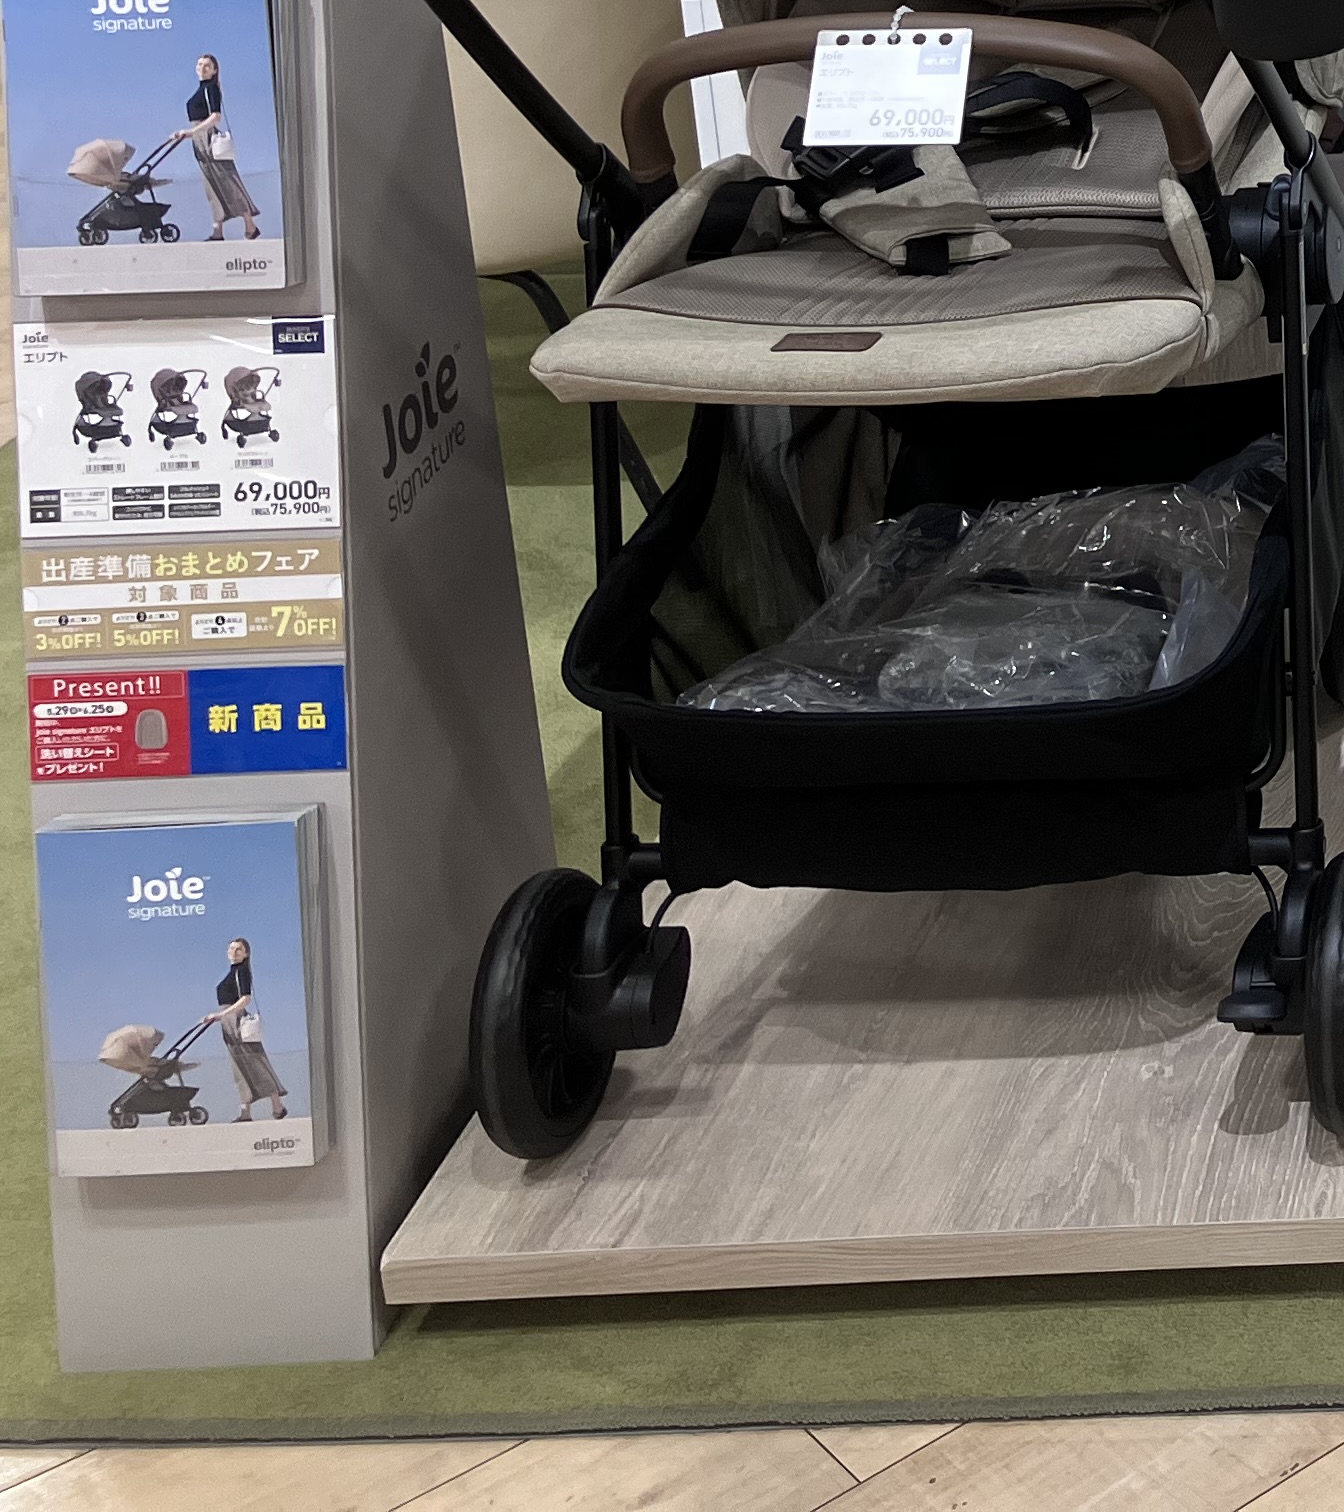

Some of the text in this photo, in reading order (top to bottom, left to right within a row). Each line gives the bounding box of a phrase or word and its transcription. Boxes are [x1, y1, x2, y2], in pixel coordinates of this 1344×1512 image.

[93, 16, 173, 33] signature
[821, 50, 844, 61] Joie
[869, 108, 955, 127] 69,000円
[225, 257, 268, 275] elipto
[22, 331, 49, 344] Joie
[278, 332, 319, 343] SELECT
[23, 351, 68, 364] エリプト
[382, 340, 459, 479] Joie
[388, 419, 465, 522] signature
[234, 479, 330, 502] 69,000円
[41, 548, 319, 583] 出産準備おまとめフェア
[128, 582, 240, 603] 対象商品
[35, 632, 102, 651] 3%OFF!
[113, 627, 180, 647] 5%OFF!
[53, 675, 161, 698] Present!!
[207, 701, 327, 735] 新商品
[126, 867, 205, 903] Joie
[128, 903, 206, 921] signature
[254, 1137, 296, 1153] elipto
